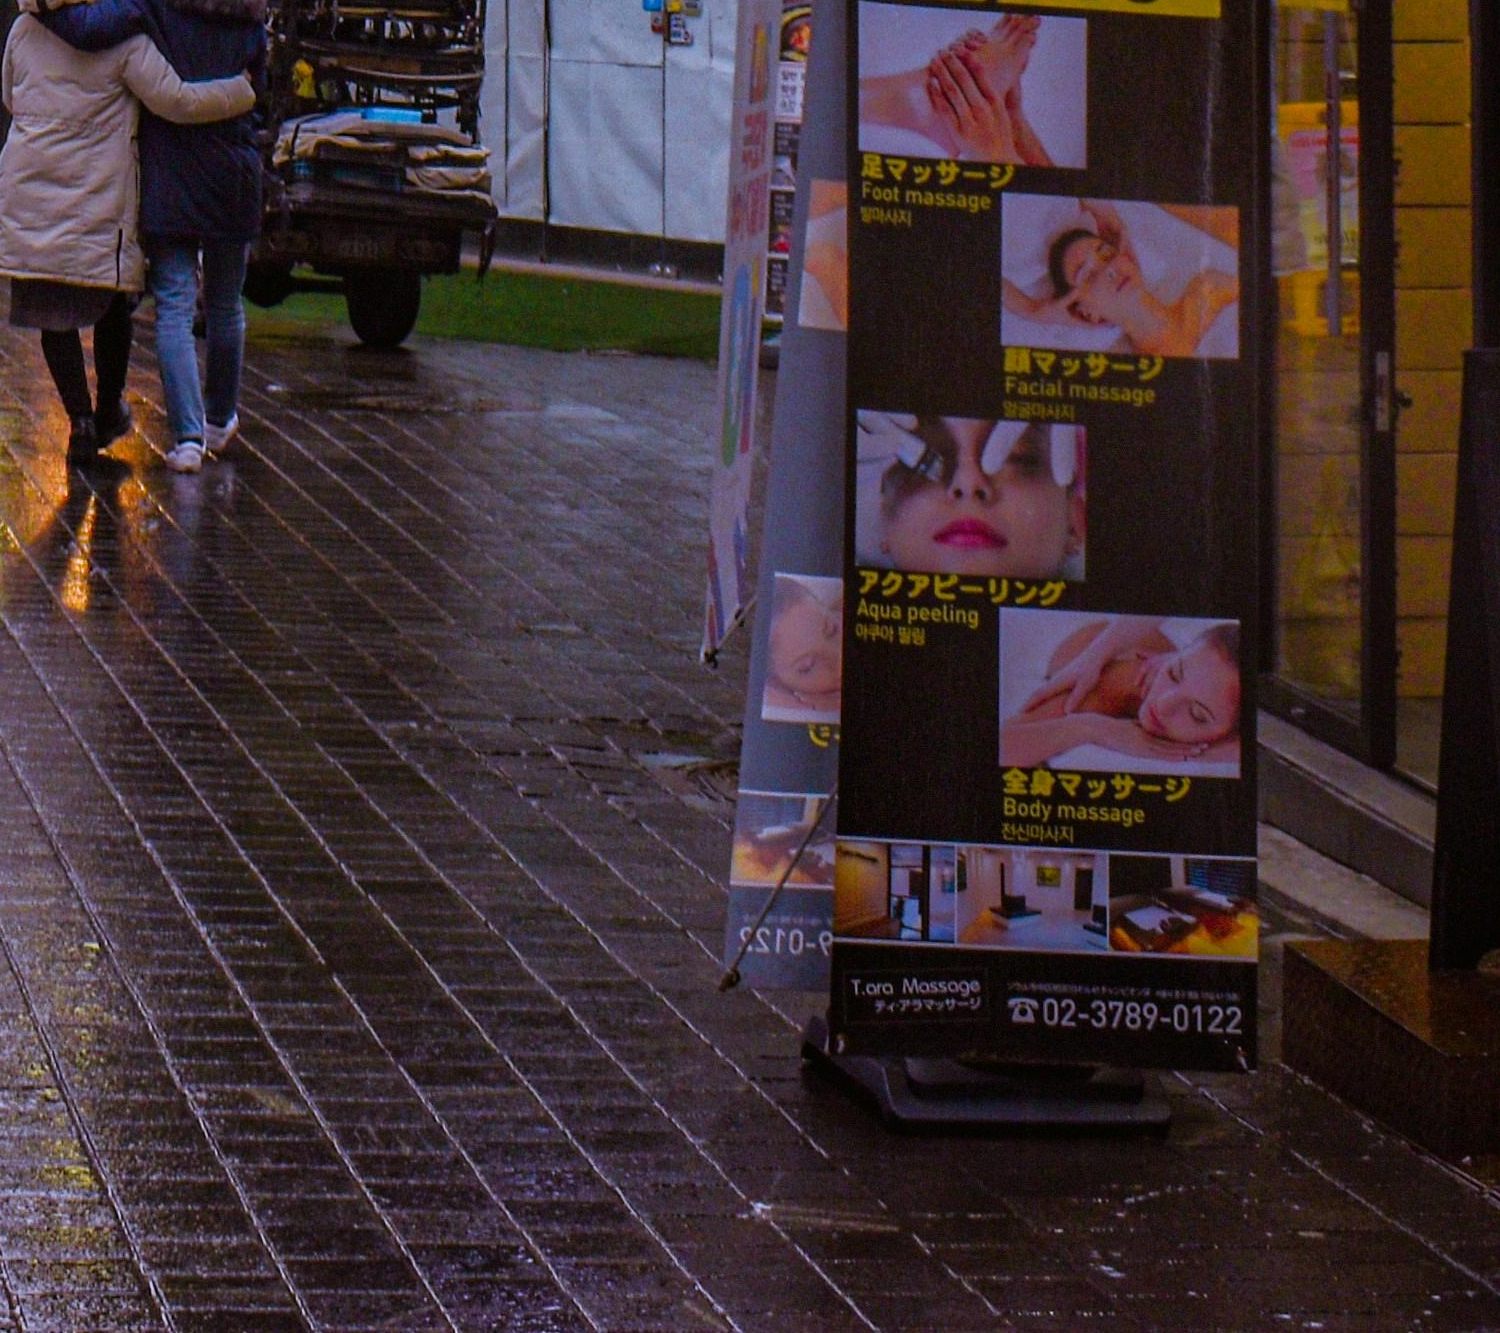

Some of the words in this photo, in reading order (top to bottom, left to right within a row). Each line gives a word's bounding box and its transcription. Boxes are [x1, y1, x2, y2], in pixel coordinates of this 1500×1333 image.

[860, 152, 1017, 189] 足マッサージ
[861, 182, 903, 205] Foot
[905, 187, 993, 213] massage
[1004, 375, 1064, 399] Facial
[1069, 379, 1157, 406] massage
[856, 568, 1067, 607] アクアピーリング
[856, 597, 903, 623] Aqua
[907, 603, 980, 629] peeling
[1002, 769, 1194, 804] 全身マッサージ
[1003, 797, 1052, 823] Body
[1057, 801, 1147, 826] massage
[901, 977, 981, 1003] Massage
[1042, 998, 1243, 1035] 02-3789-0122
